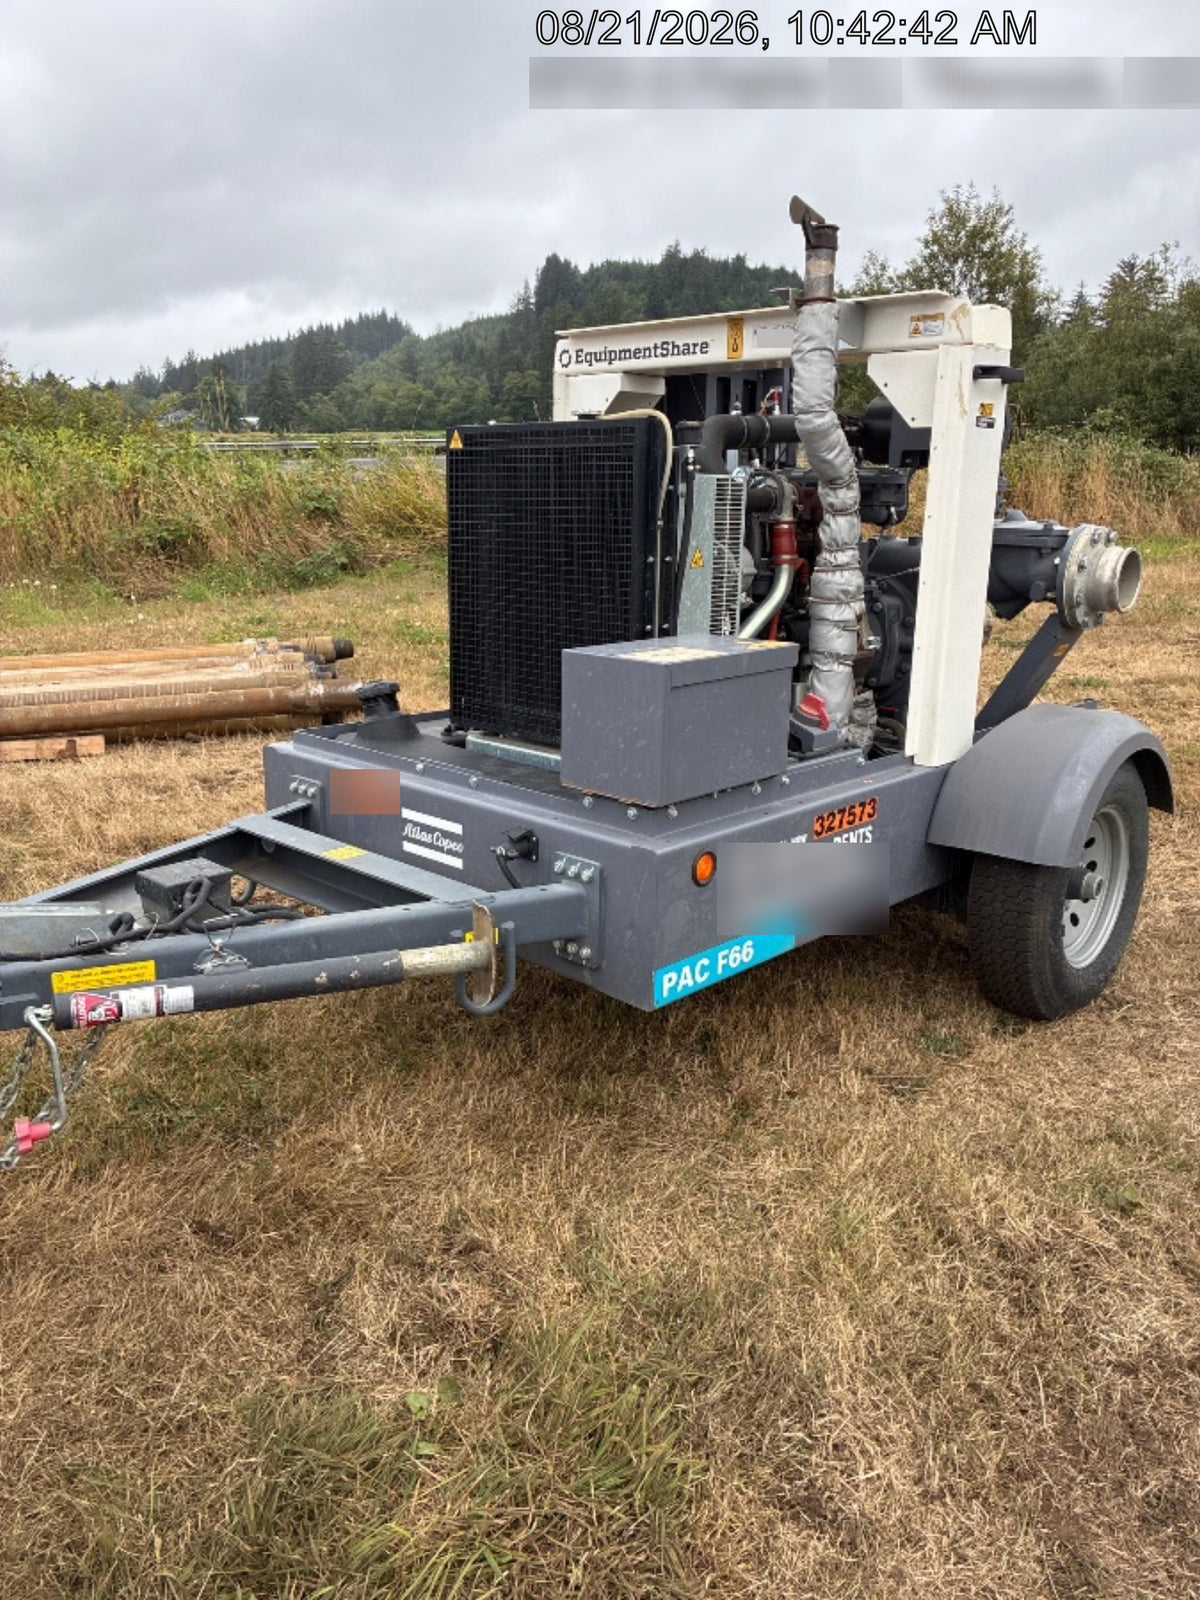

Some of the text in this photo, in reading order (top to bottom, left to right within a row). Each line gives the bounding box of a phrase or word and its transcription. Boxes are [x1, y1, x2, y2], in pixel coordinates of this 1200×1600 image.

[575, 340, 710, 366] EquipmentShare
[813, 797, 877, 837] 327573
[403, 822, 464, 853] Atlas Copco
[662, 940, 754, 998] PAC F66
